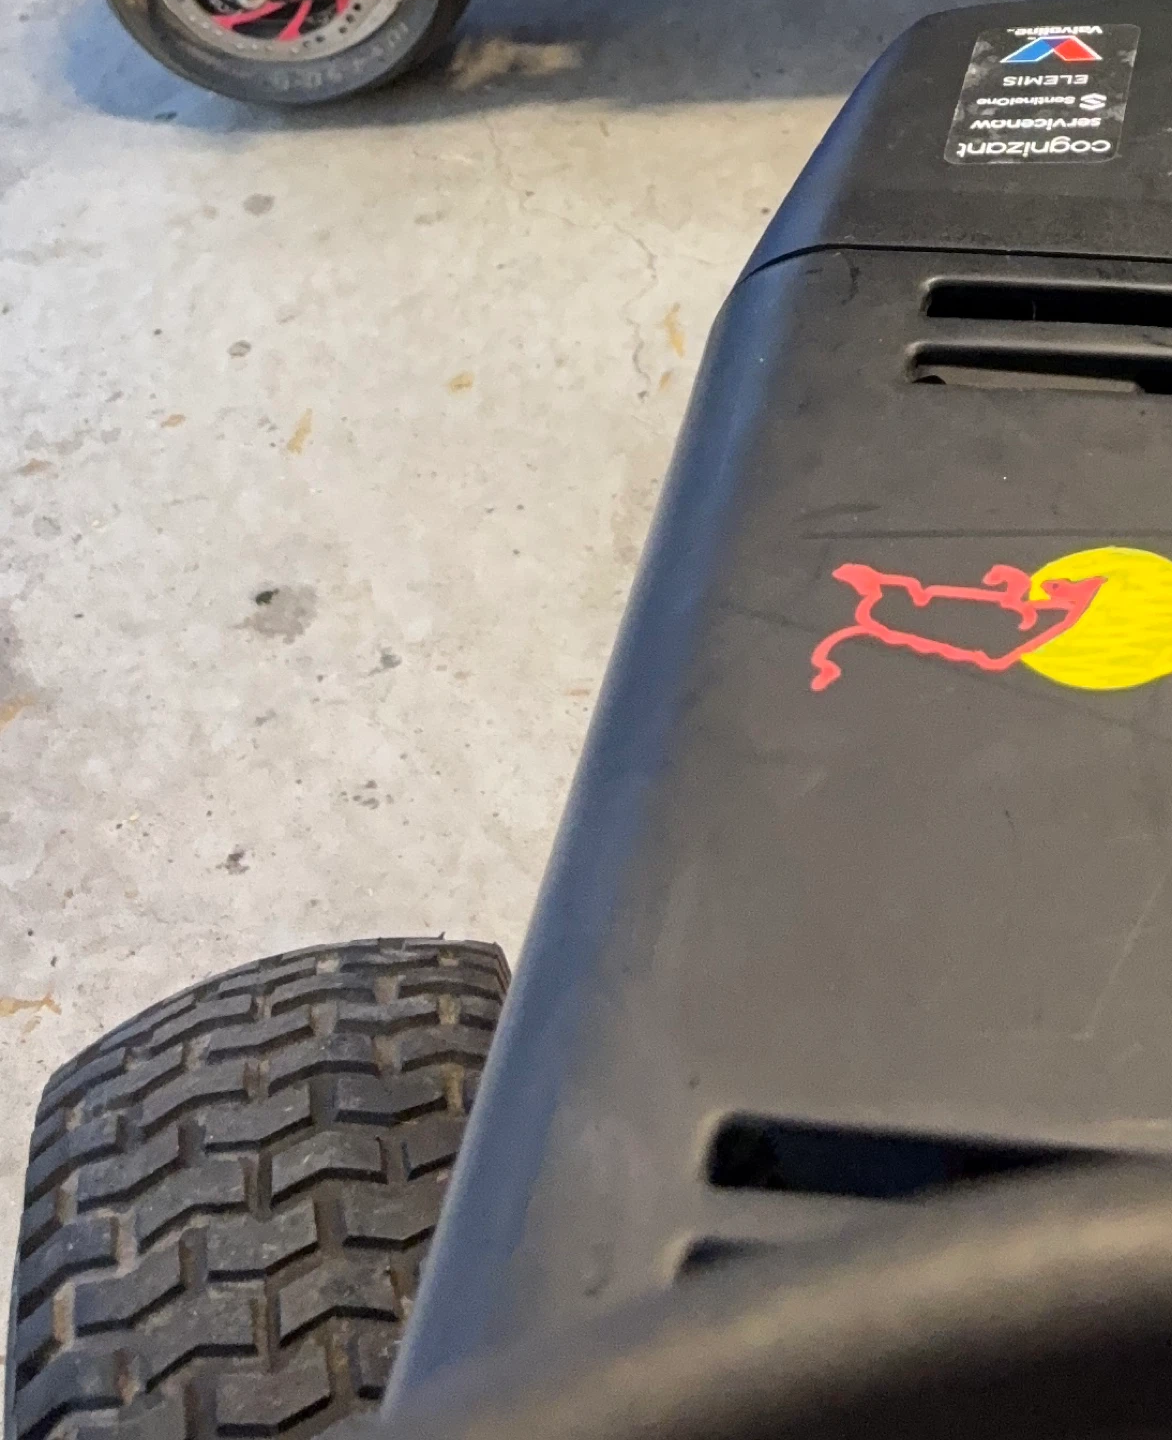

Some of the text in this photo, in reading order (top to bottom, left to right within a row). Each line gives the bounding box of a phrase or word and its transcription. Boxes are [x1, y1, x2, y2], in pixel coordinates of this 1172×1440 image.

[1014, 25, 1103, 36] Valvoline
[1003, 74, 1089, 87] ELEMIS
[970, 117, 1102, 131] servicenow
[956, 136, 1111, 158] cognizant
